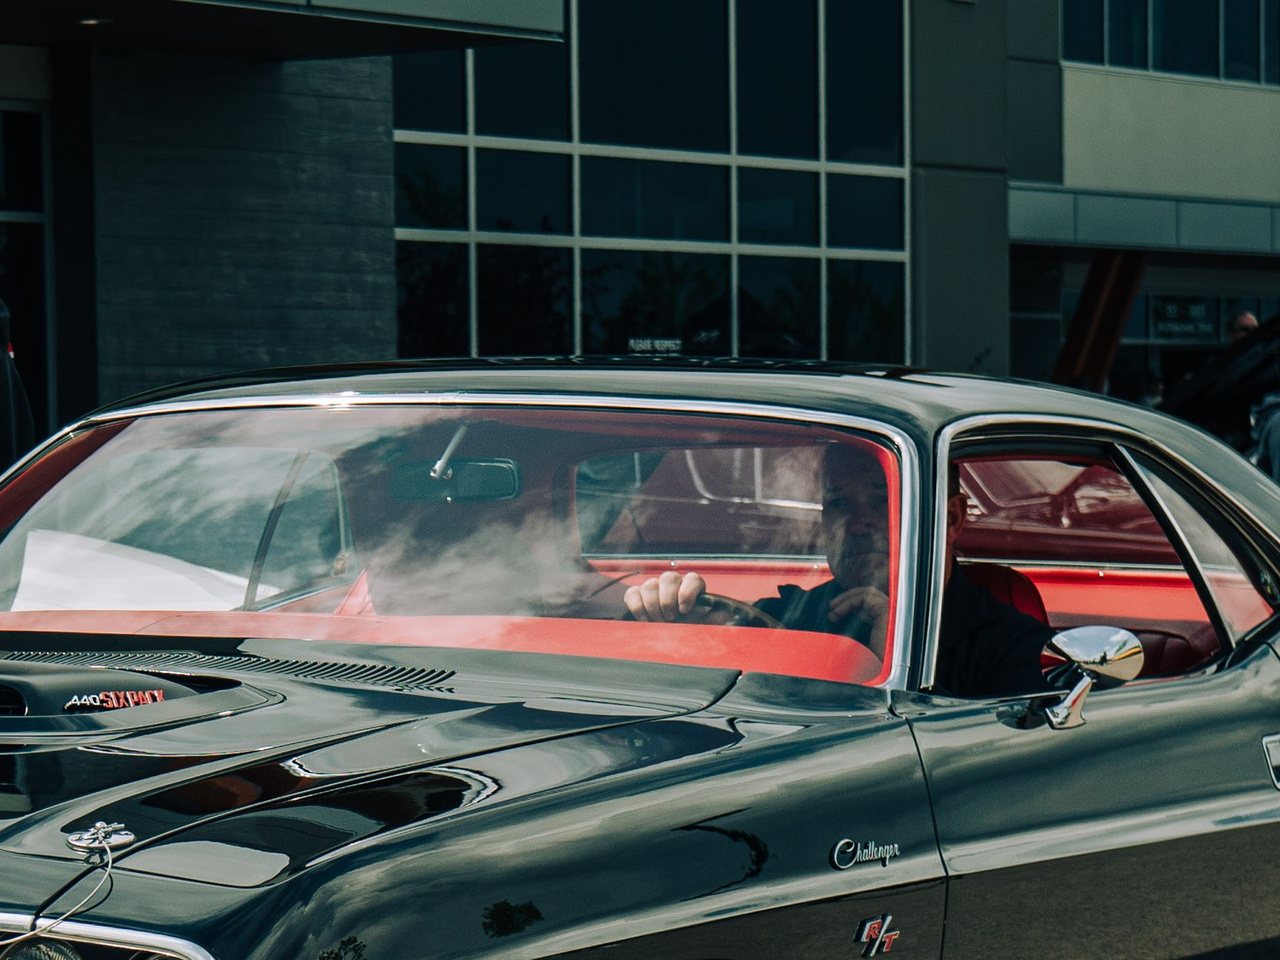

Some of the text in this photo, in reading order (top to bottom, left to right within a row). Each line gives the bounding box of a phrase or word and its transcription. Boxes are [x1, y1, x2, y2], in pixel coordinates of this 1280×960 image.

[67, 694, 101, 707] 440
[834, 838, 900, 869] Challenger
[860, 915, 900, 957] R/T
